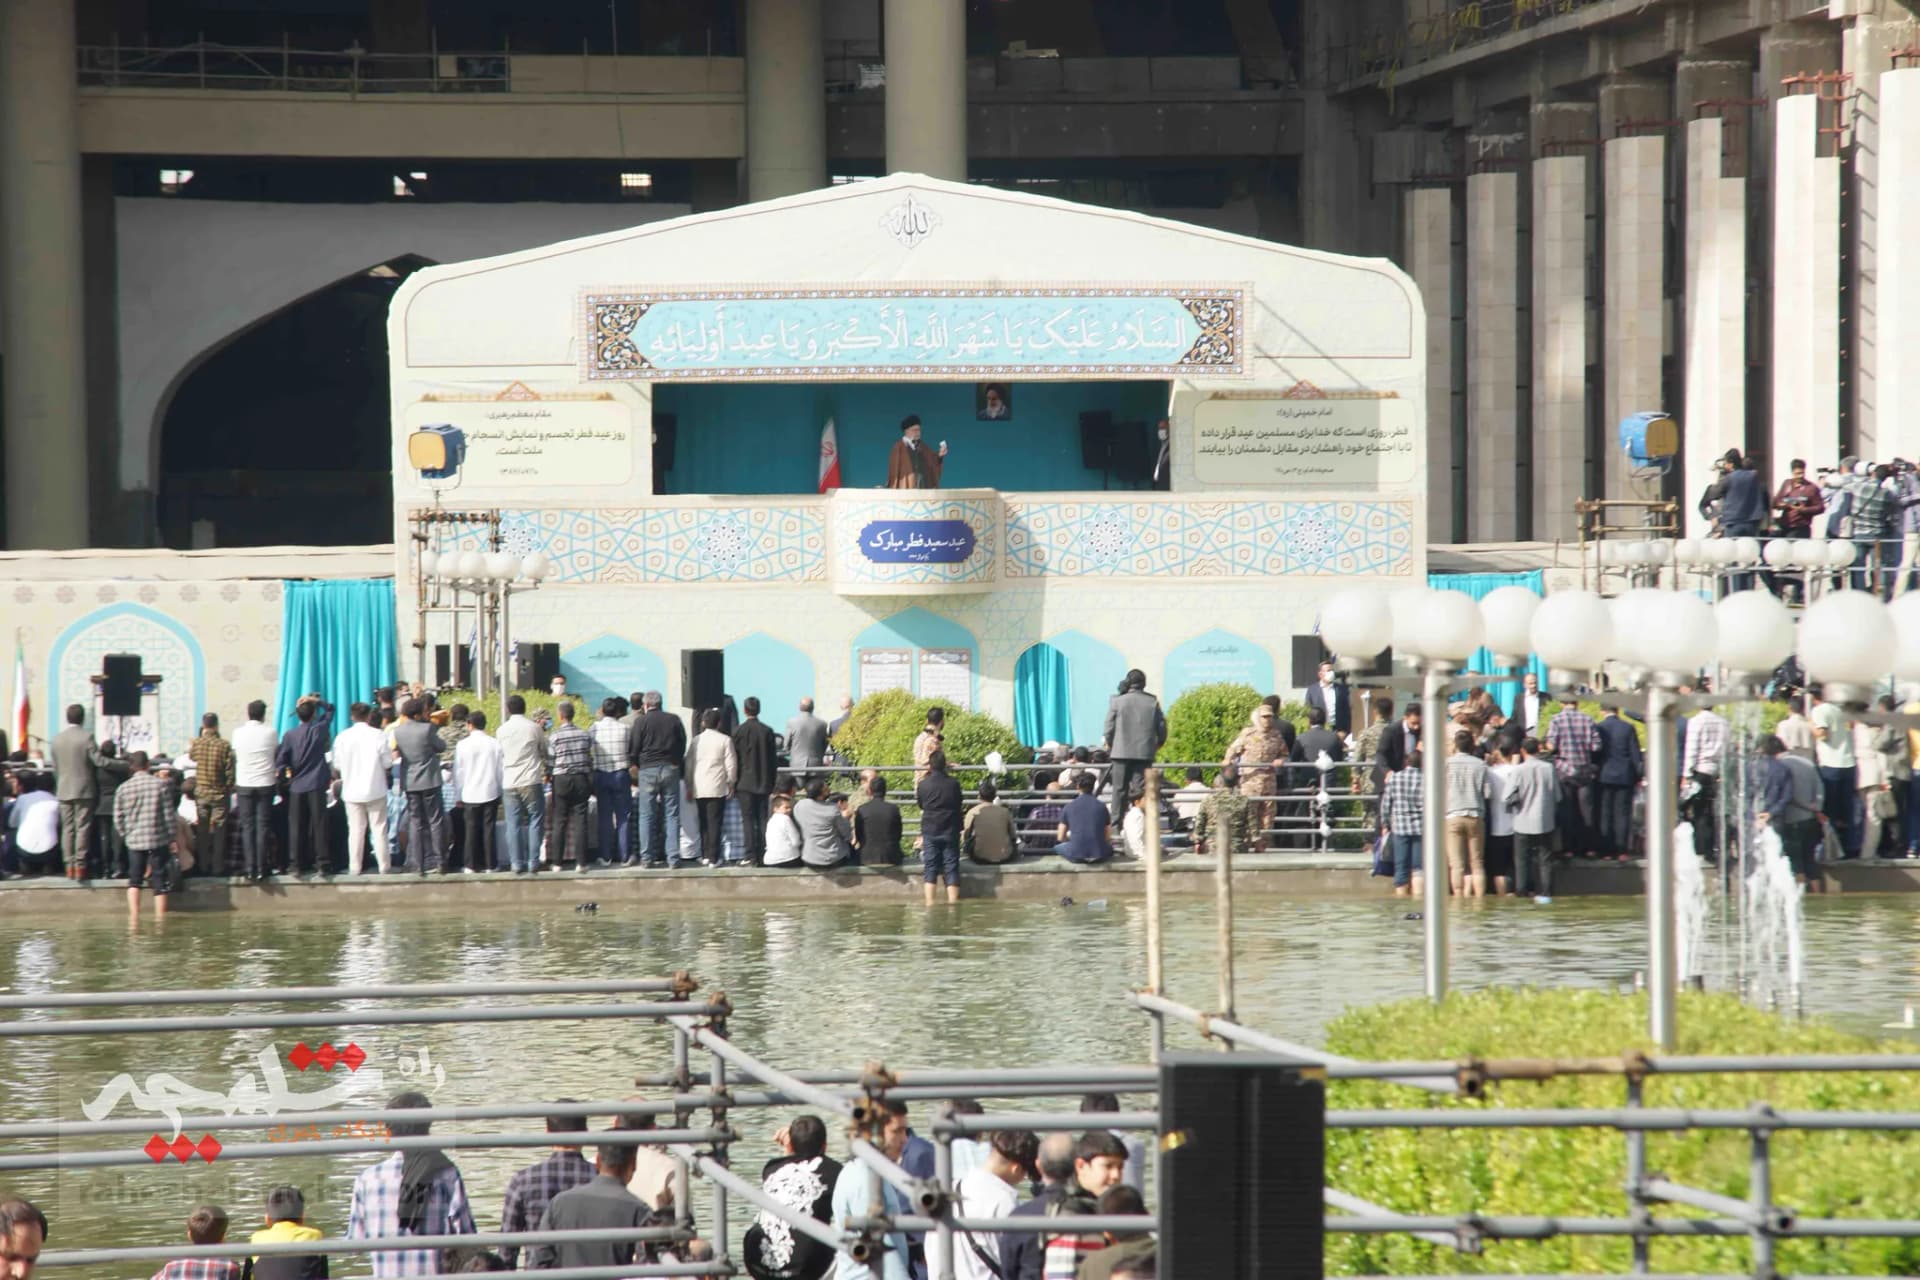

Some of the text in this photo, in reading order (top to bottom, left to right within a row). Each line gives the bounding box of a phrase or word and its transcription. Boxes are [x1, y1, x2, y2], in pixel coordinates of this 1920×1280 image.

[505, 428, 537, 441] نمایش
[546, 428, 574, 442] تجسم
[574, 426, 593, 441] فطر
[594, 431, 611, 441] عید
[1201, 428, 1219, 437] داده
[1220, 426, 1236, 440] قرار
[1237, 430, 1254, 440] عید
[1256, 427, 1295, 440] مسلمین
[1297, 427, 1314, 439] برای
[1344, 427, 1367, 436] است
[522, 444, 543, 455] ملت
[1234, 444, 1271, 455] دشمنان
[1272, 444, 1298, 455] مقابل
[1311, 443, 1344, 455] راهشان
[1345, 444, 1365, 455] خود
[869, 528, 966, 551] عید سعید فطر مبارک
